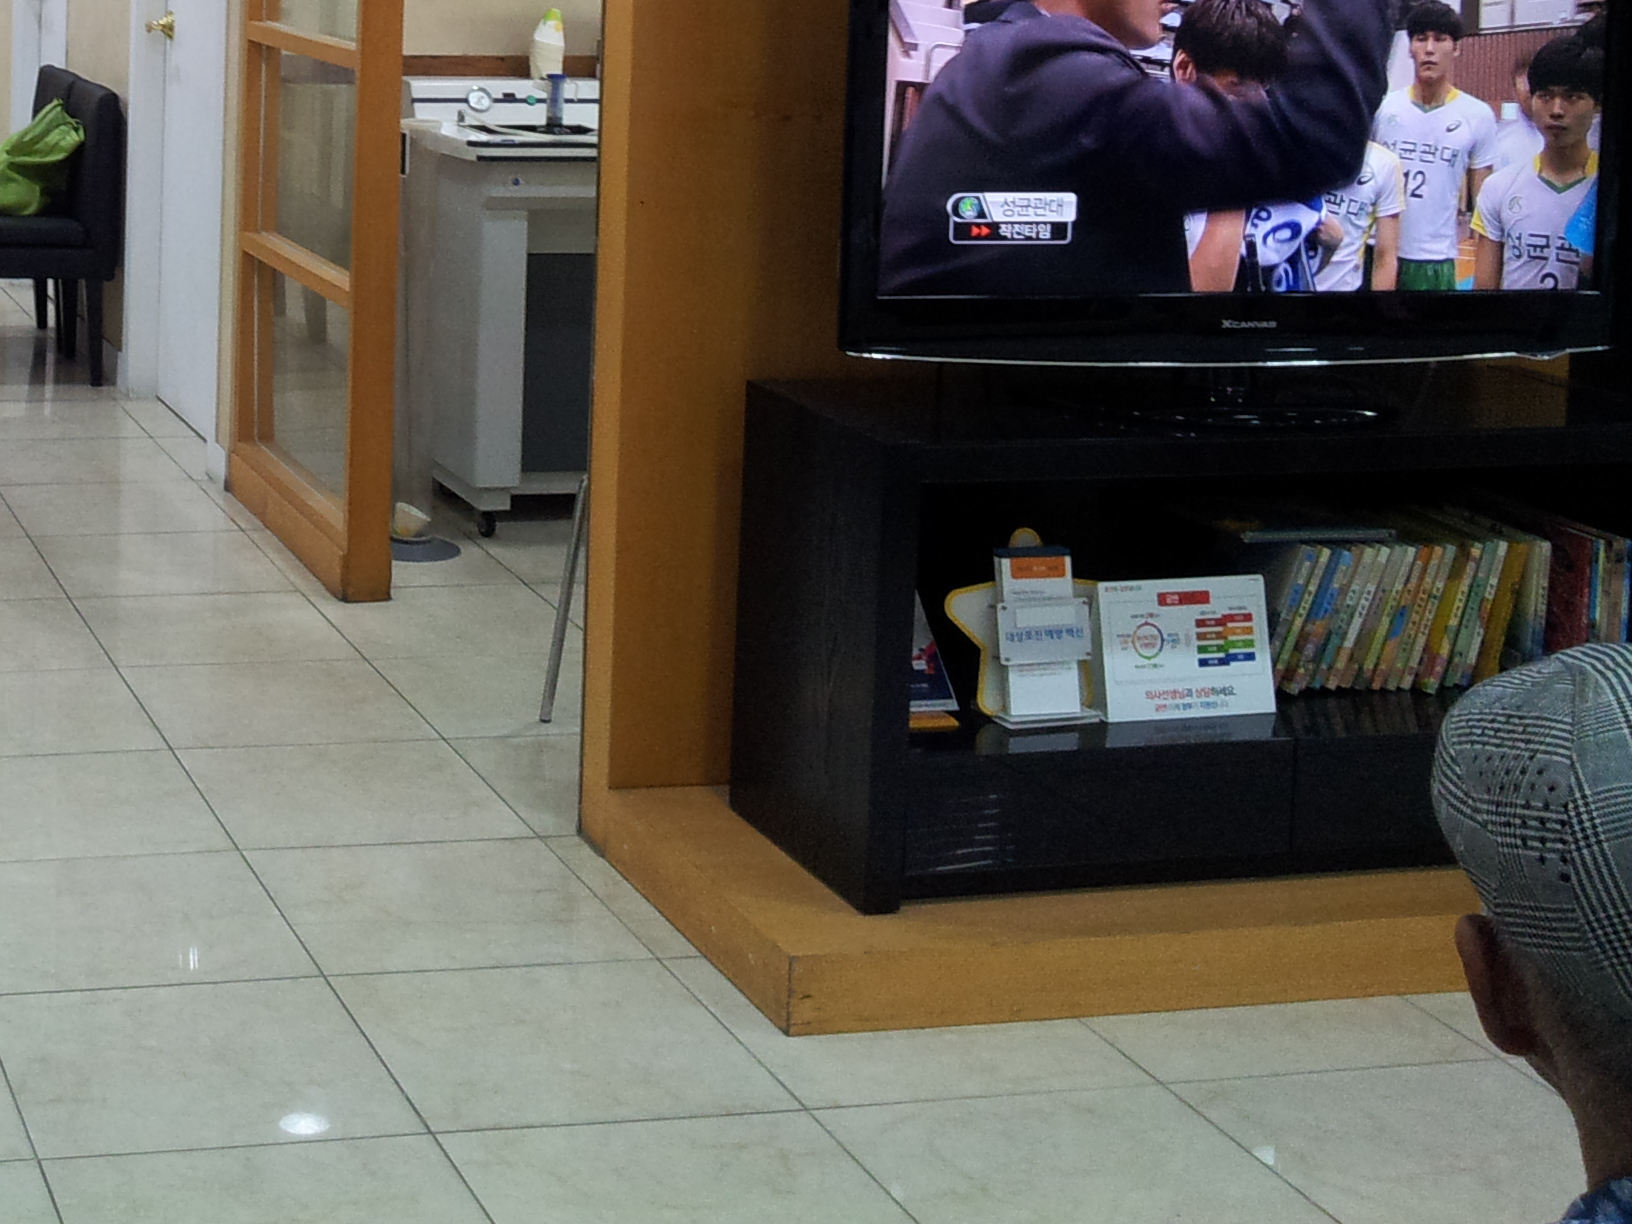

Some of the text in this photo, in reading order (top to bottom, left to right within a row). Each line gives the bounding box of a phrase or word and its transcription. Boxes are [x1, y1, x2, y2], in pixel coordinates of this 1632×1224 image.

[1403, 169, 1427, 199] 12
[1000, 196, 1065, 218] 성균관대
[998, 224, 1052, 239] 작전타임
[1507, 231, 1580, 266] 성균관
